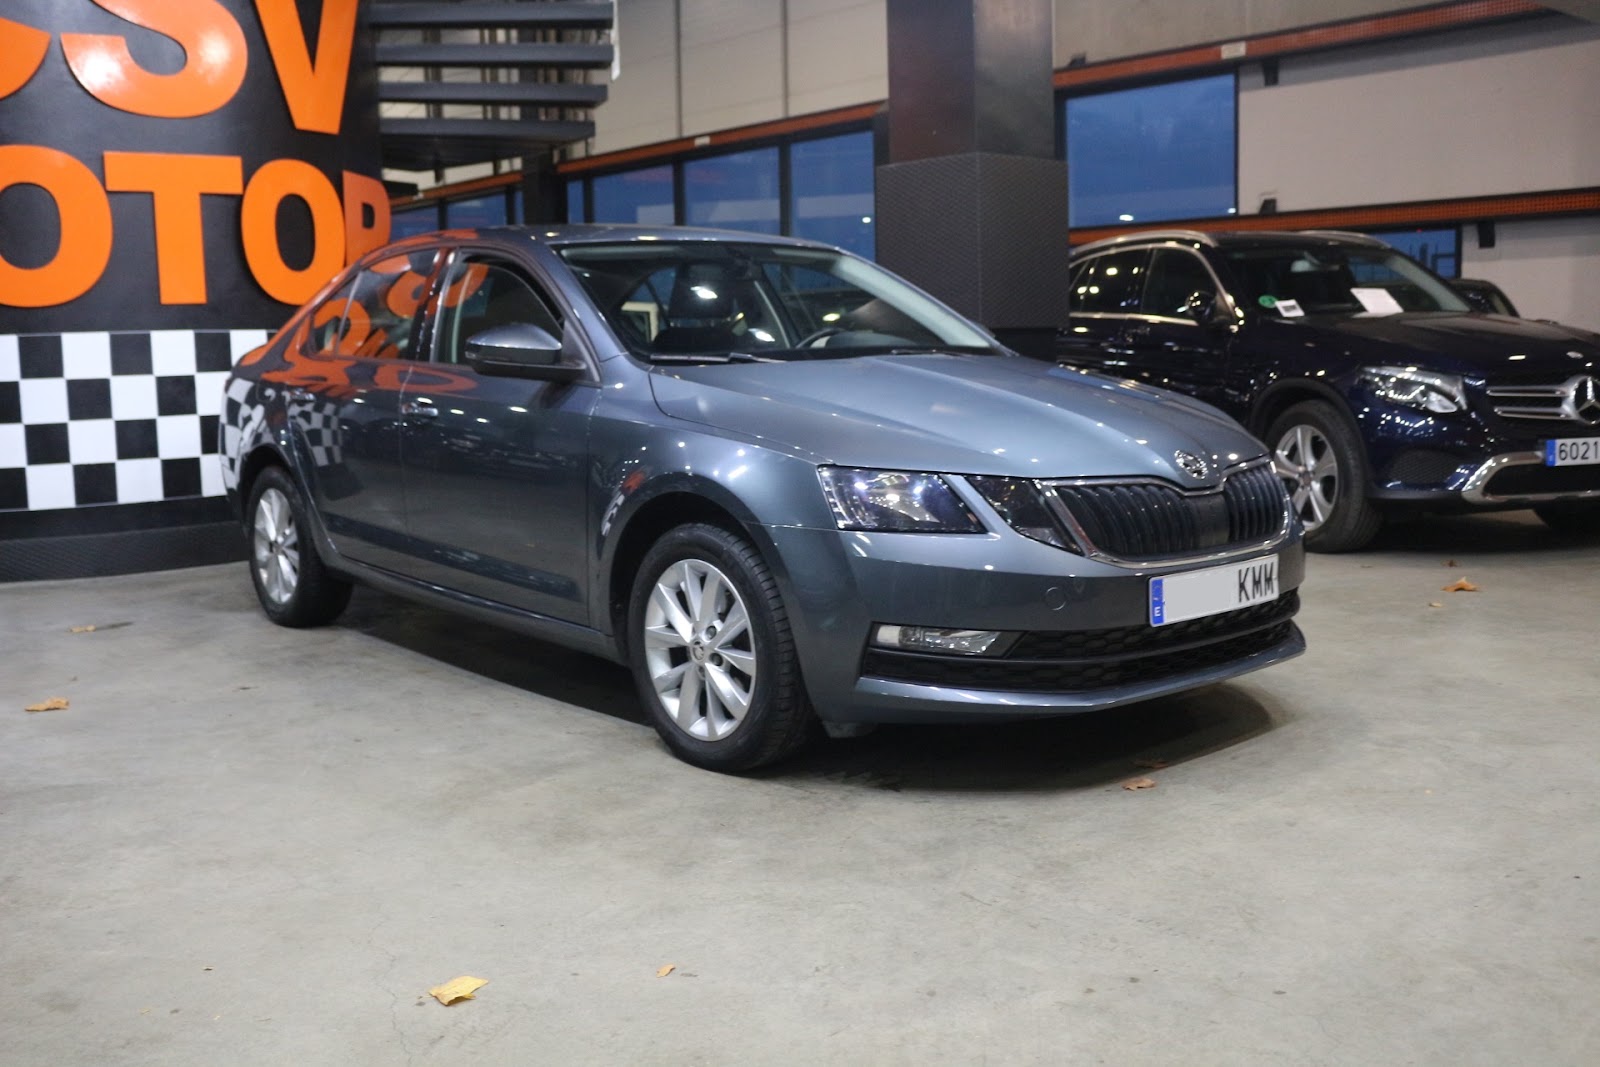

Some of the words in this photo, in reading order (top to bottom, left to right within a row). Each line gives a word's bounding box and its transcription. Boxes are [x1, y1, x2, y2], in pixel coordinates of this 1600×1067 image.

[0, 0, 359, 134] SV
[1558, 441, 1598, 461] 6021
[1238, 562, 1274, 603] KMM
